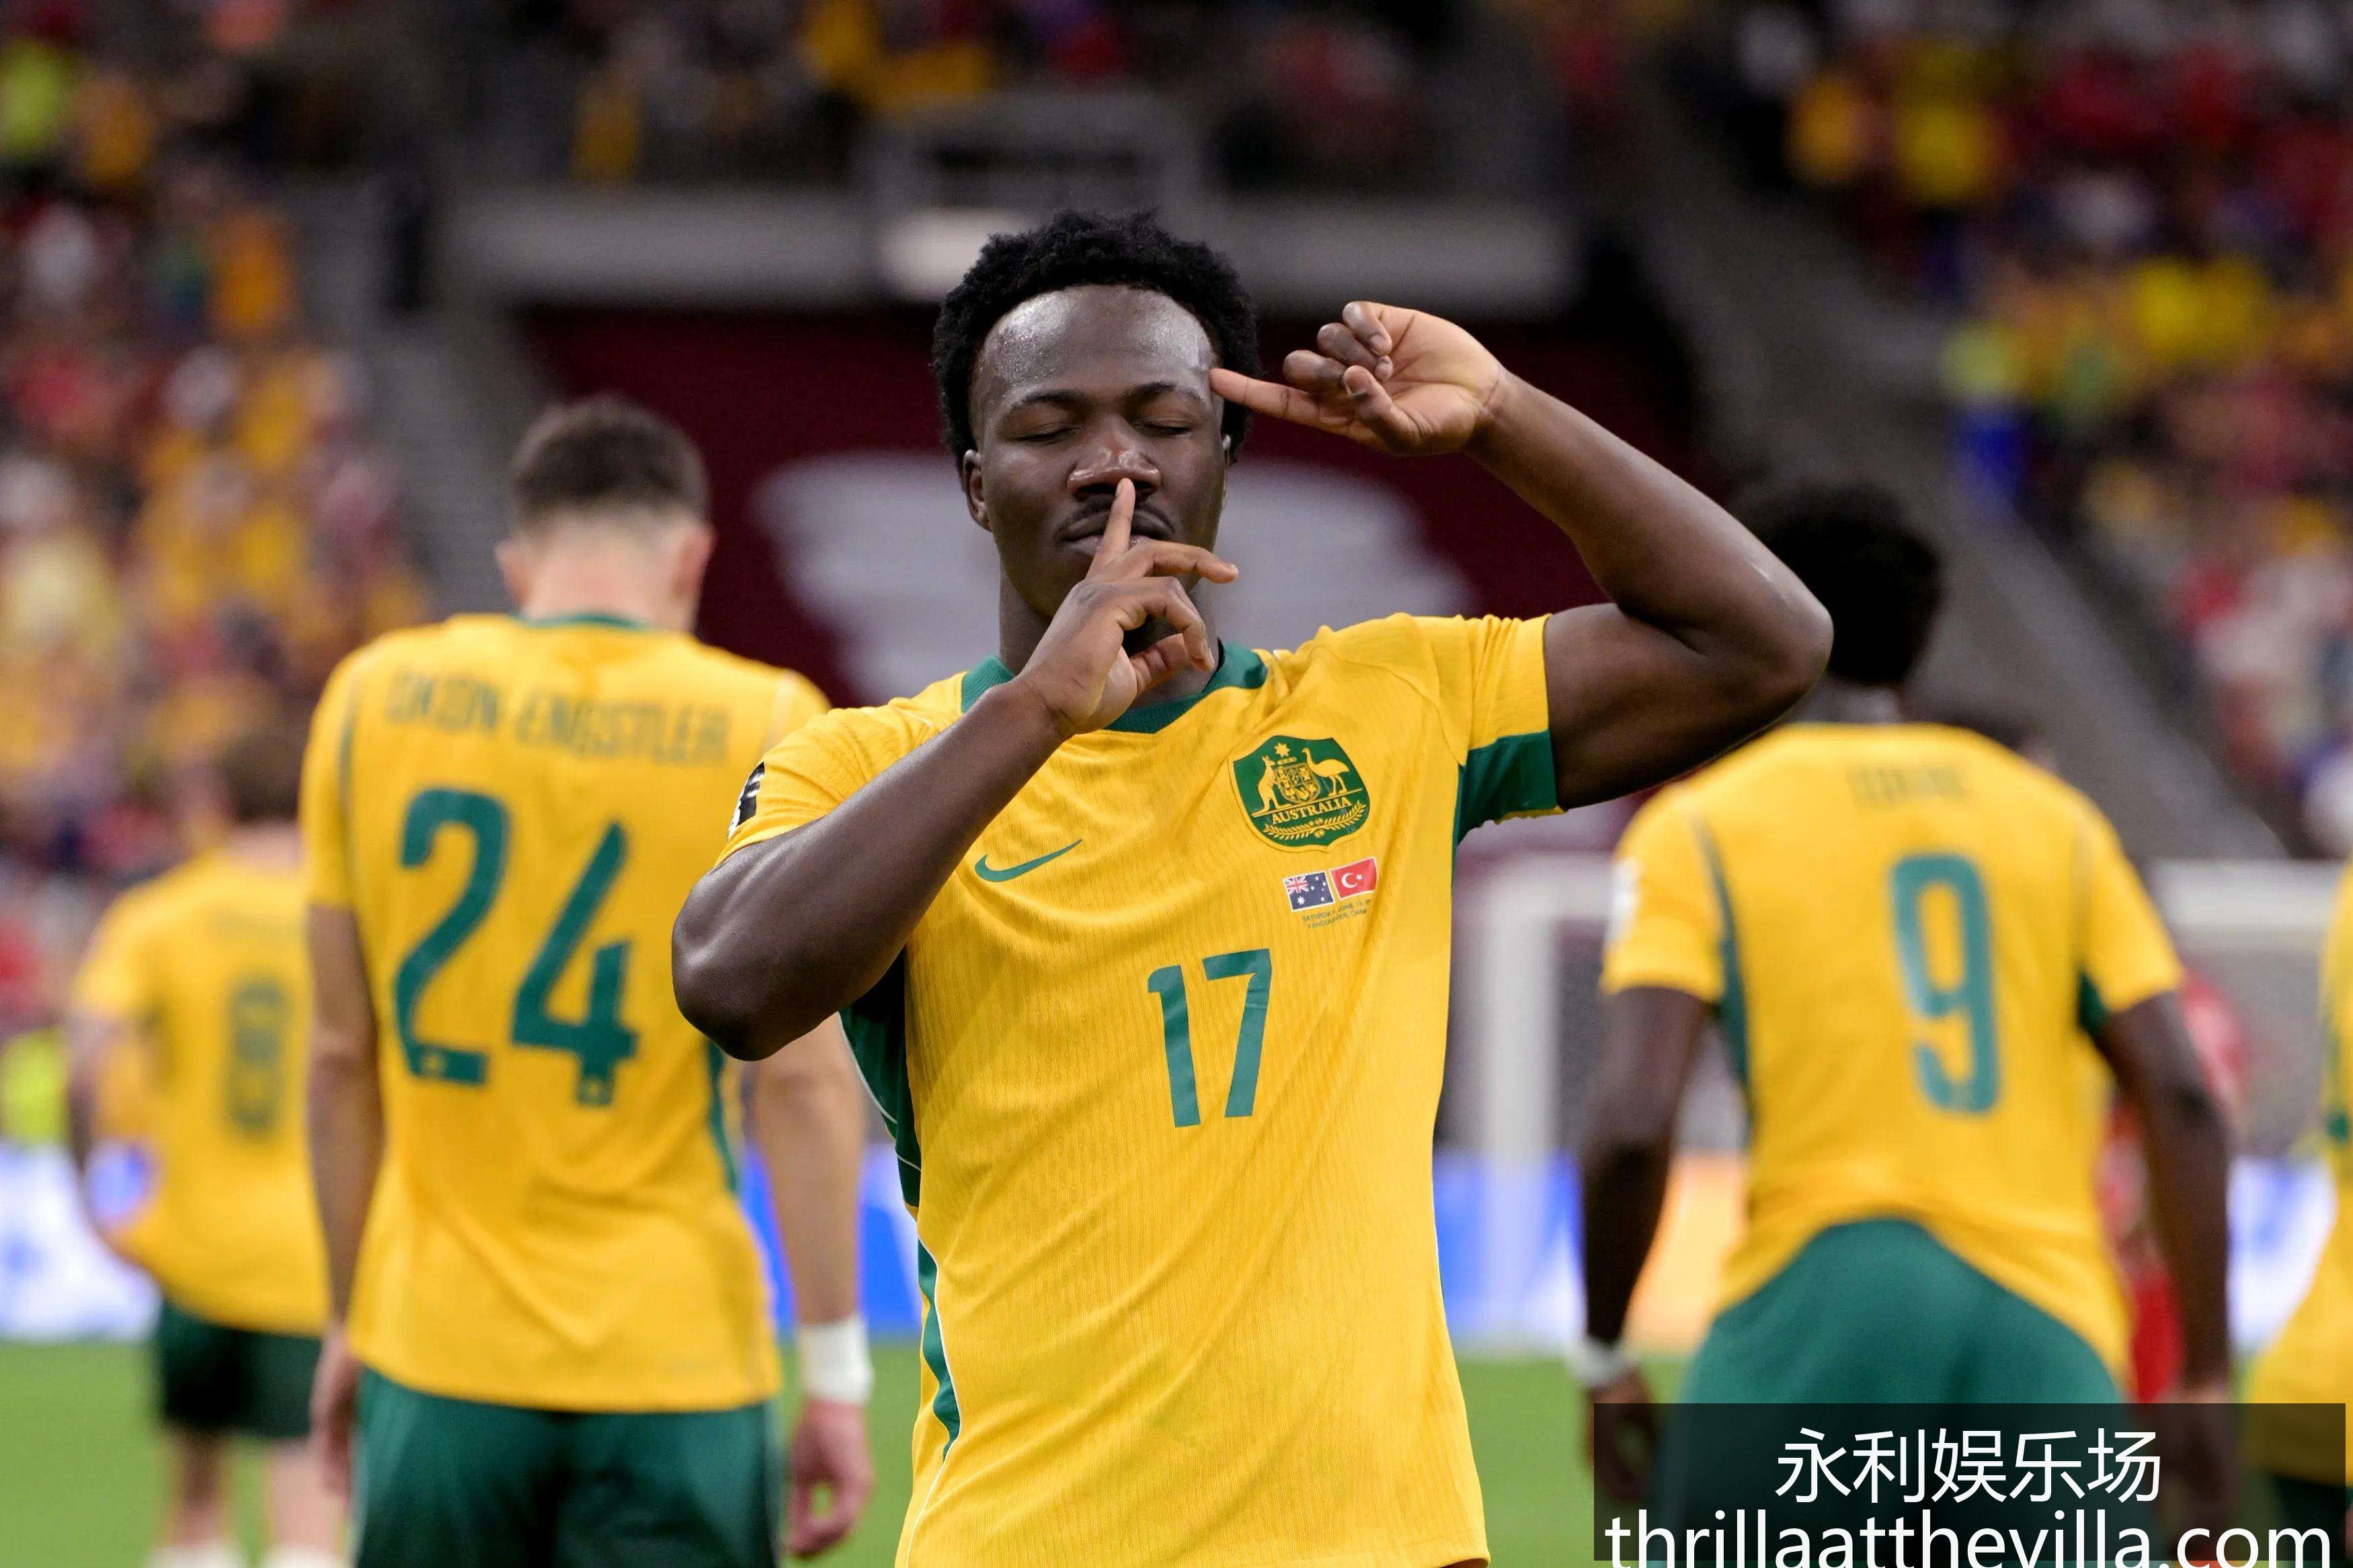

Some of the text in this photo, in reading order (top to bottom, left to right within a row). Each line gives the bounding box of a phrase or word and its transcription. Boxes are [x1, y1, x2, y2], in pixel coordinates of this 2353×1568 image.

[1271, 796, 1353, 825] AUSTRALIA
[393, 786, 639, 1108] 24
[1147, 948, 1272, 1128] 17
[1890, 852, 2000, 1114] 9
